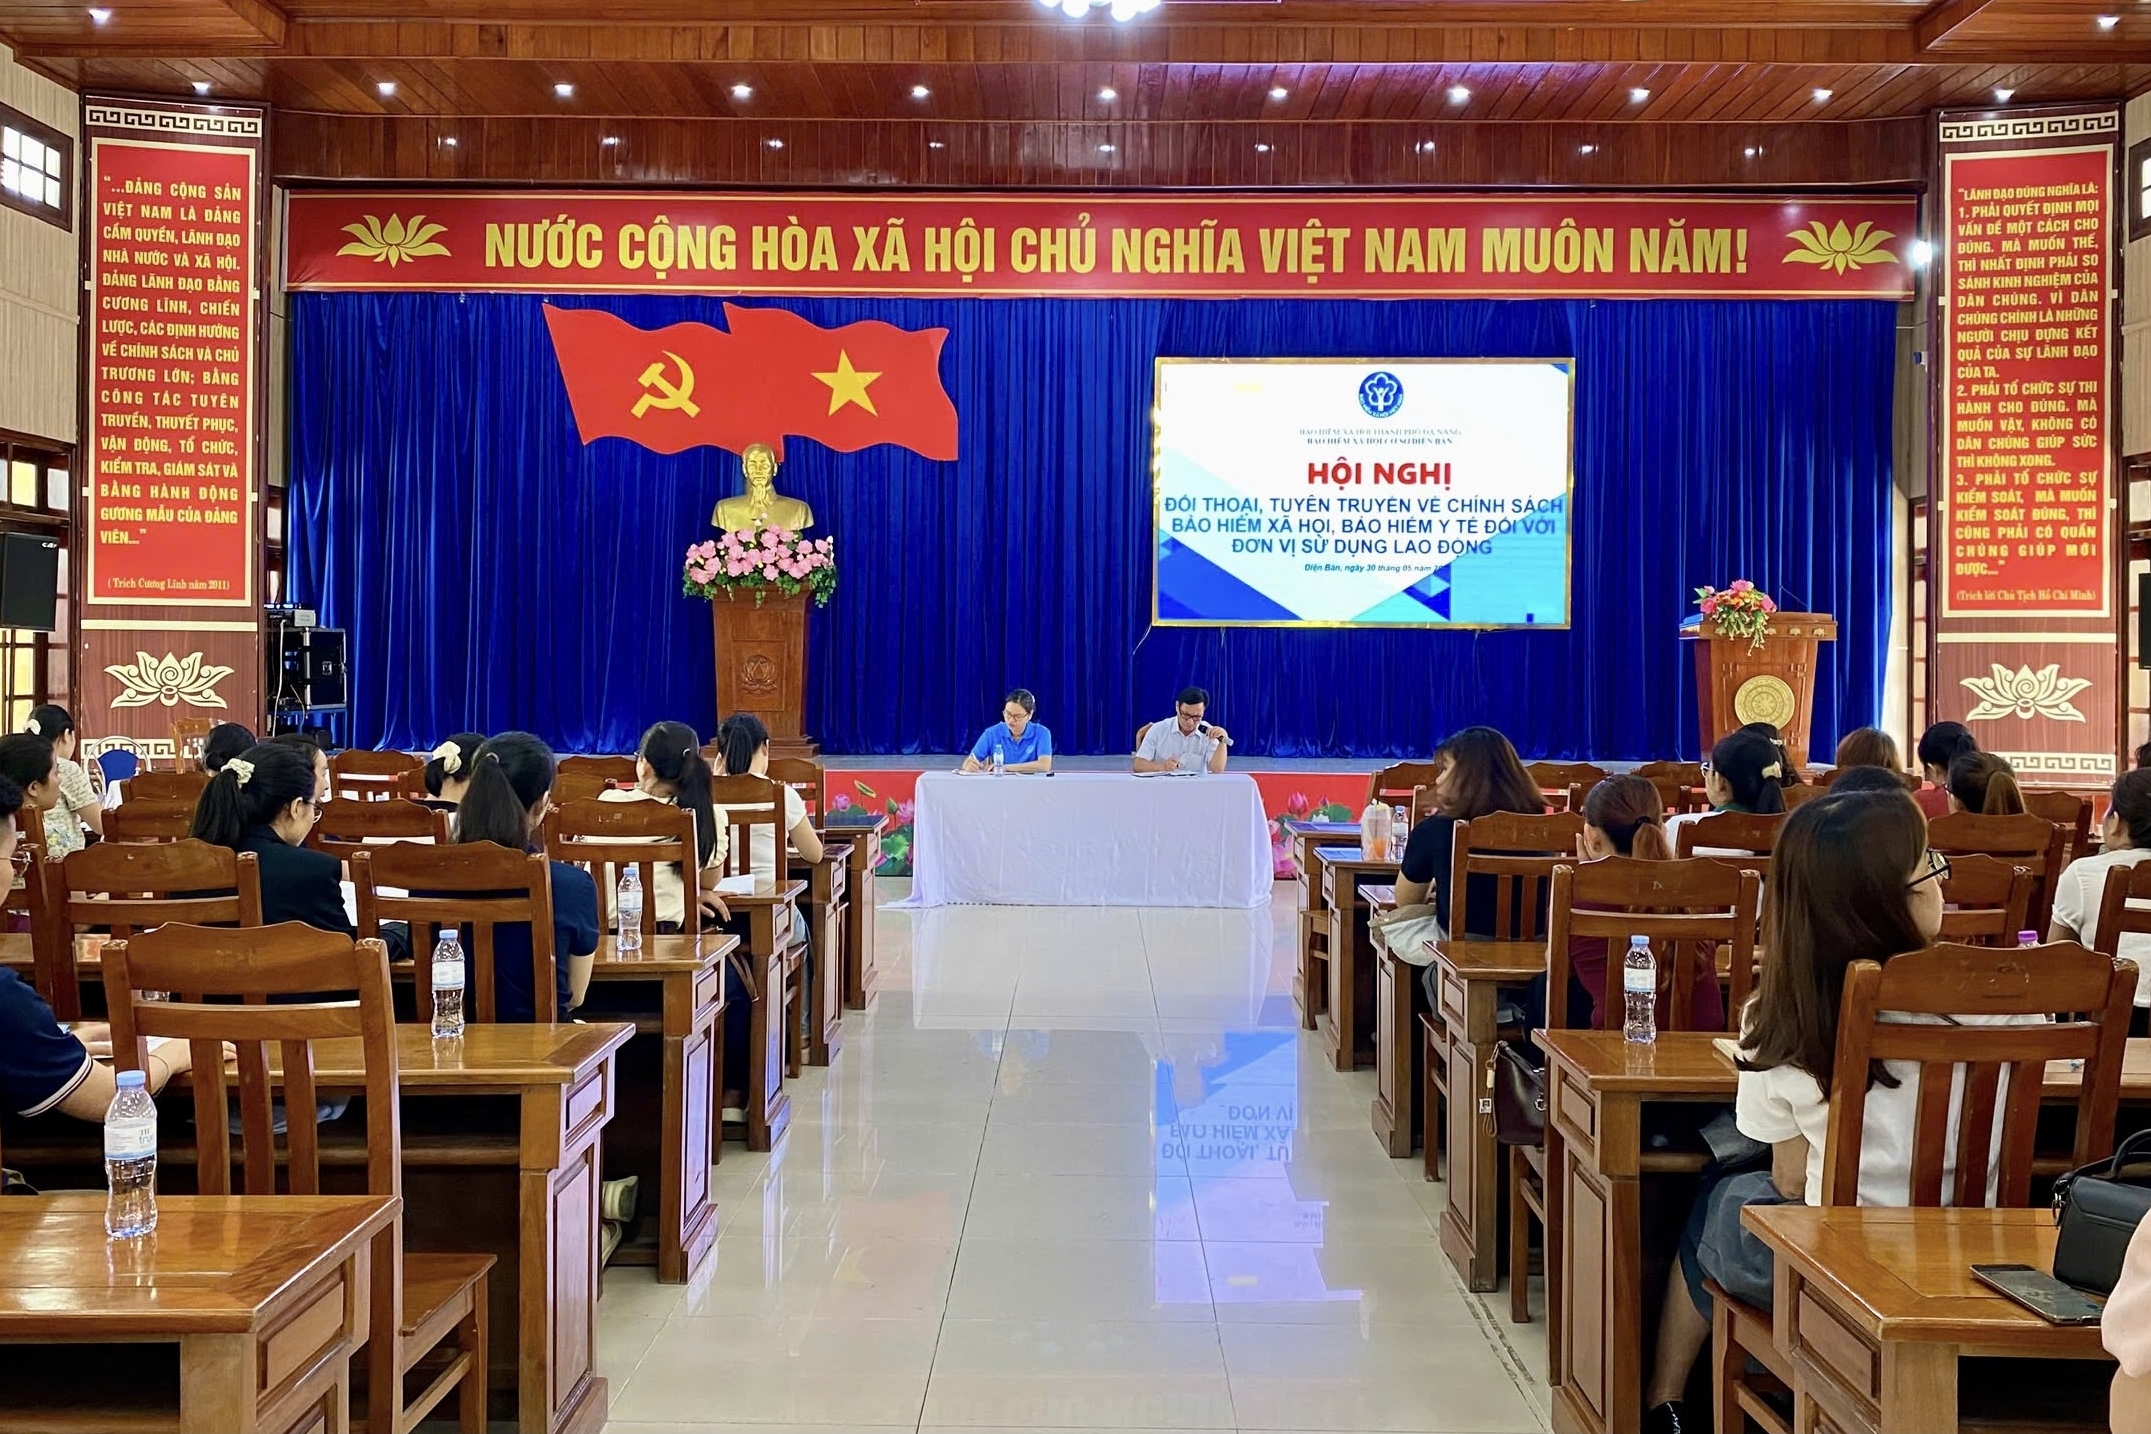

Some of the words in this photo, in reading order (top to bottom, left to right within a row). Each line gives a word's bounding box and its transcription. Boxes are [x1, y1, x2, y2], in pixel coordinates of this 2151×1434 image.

[170, 181, 206, 200] CỘNG
[214, 182, 240, 200] SẢN
[1992, 187, 2014, 201] ĐẠO
[2015, 184, 2045, 198] ĐÚNG
[2047, 182, 2080, 196] NGHĨA
[2082, 181, 2097, 193] LÀ:
[103, 200, 132, 219] VIỆT
[141, 204, 171, 219] NAM
[180, 205, 196, 220] LÀ
[204, 204, 240, 223] ĐẢNG
[1972, 201, 1999, 217] PHẢI
[2002, 199, 2040, 217] QUYẾT
[2042, 201, 2071, 216] ĐỊNH
[2075, 199, 2098, 214] MỌI
[1958, 219, 1981, 236] VẤN
[2006, 219, 2032, 236] MỘT
[2037, 217, 2069, 232] CÁCH
[2074, 217, 2098, 230] CHO
[182, 228, 213, 245] LÃNH
[216, 232, 240, 249] ĐẠO
[485, 214, 602, 268] NƯỚC
[619, 215, 736, 279] CỘNG
[752, 216, 838, 271] HÒA
[852, 218, 910, 271] XÃ
[925, 218, 994, 283] HỘI
[1011, 212, 1096, 274] CHỦ
[1110, 219, 1243, 273] NGHĨA
[1259, 219, 1350, 283] VIỆT
[1365, 228, 1466, 272] NAM
[1482, 218, 1613, 273] MUÔN
[1630, 219, 1747, 273] NĂM!
[1957, 238, 1993, 254] ĐÚNG.
[2001, 237, 2021, 252] MÀ
[2028, 234, 2064, 251] MUỐN
[2072, 232, 2097, 249] THẾ,
[103, 247, 128, 263] NHÀ
[134, 248, 167, 265] NƯỚC
[173, 251, 189, 266] VÀ
[195, 252, 211, 268] XÃ
[216, 253, 240, 272] HỘI.
[1957, 257, 1976, 271] THÌ
[1980, 254, 2011, 271] NHẤT
[2015, 256, 2044, 271] ĐỊNH
[2049, 251, 2077, 267] PHẢI
[2082, 254, 2097, 266] SO
[102, 269, 136, 287] ĐẢNG
[142, 273, 173, 289] LÃNH
[177, 277, 202, 293] ĐẠO
[207, 274, 239, 292] BẰNG
[102, 295, 148, 311] CƯƠNG
[157, 297, 191, 314] LĨNH,
[200, 297, 239, 315] CHIẾN
[102, 319, 137, 336] LƯỢC,
[140, 319, 164, 335] CÁC
[166, 323, 196, 339] ĐỊNH
[198, 322, 239, 339] HƯỚNG
[120, 341, 157, 358] CHÍNH
[161, 343, 193, 360] SÁCH
[196, 345, 212, 361] VÀ
[215, 345, 239, 362] CHỦ
[101, 365, 155, 381] TRƯƠNG
[202, 366, 238, 385] BẰNG
[1957, 362, 1981, 378] CỦA
[1983, 365, 1999, 377] TA.
[101, 387, 142, 404] CÔNG
[153, 389, 180, 406] TÁC
[190, 391, 238, 408] TUYÊN
[1971, 380, 1999, 396] PHẢI
[2022, 380, 2053, 394] CHỨC
[2058, 381, 2075, 395] SỰ
[2078, 381, 2096, 392] THI
[155, 411, 199, 430] THUYẾT
[202, 417, 238, 434] PHỤC,
[101, 434, 126, 453] VẬN
[133, 436, 171, 454] ĐỘNG,
[201, 438, 238, 455] CHỨC,
[100, 455, 132, 474] KIỂM
[134, 461, 161, 476] TRA,
[163, 460, 195, 476] GIÁM
[197, 461, 220, 477] SÁT
[222, 462, 238, 477] VÀ
[1309, 457, 1361, 490] HỘI
[1374, 463, 1450, 489] NGHỊ
[100, 479, 140, 497] BẰNG
[150, 482, 189, 499] HÀNH
[198, 484, 238, 503] ĐỘNG
[100, 506, 142, 521] GƯƠNG
[146, 503, 174, 522] MẪU
[177, 505, 201, 522] CỦA
[204, 506, 237, 523] ĐẢNG
[1202, 497, 1262, 516] THOẠI,
[1269, 495, 1330, 516] TUYÊN
[1448, 495, 1504, 513] CHÍNH
[1512, 495, 1562, 513] SÁCH
[1268, 515, 1292, 533] XÃ
[1438, 519, 1450, 533] Y
[1232, 539, 1272, 553] ĐƠN
[1279, 539, 1295, 557] VỊ
[1335, 539, 1387, 557] DỤNG
[1394, 539, 1431, 554] LAO
[1366, 564, 1376, 572] 30
[1402, 564, 1412, 572] 05
[209, 580, 230, 590] 2011)
